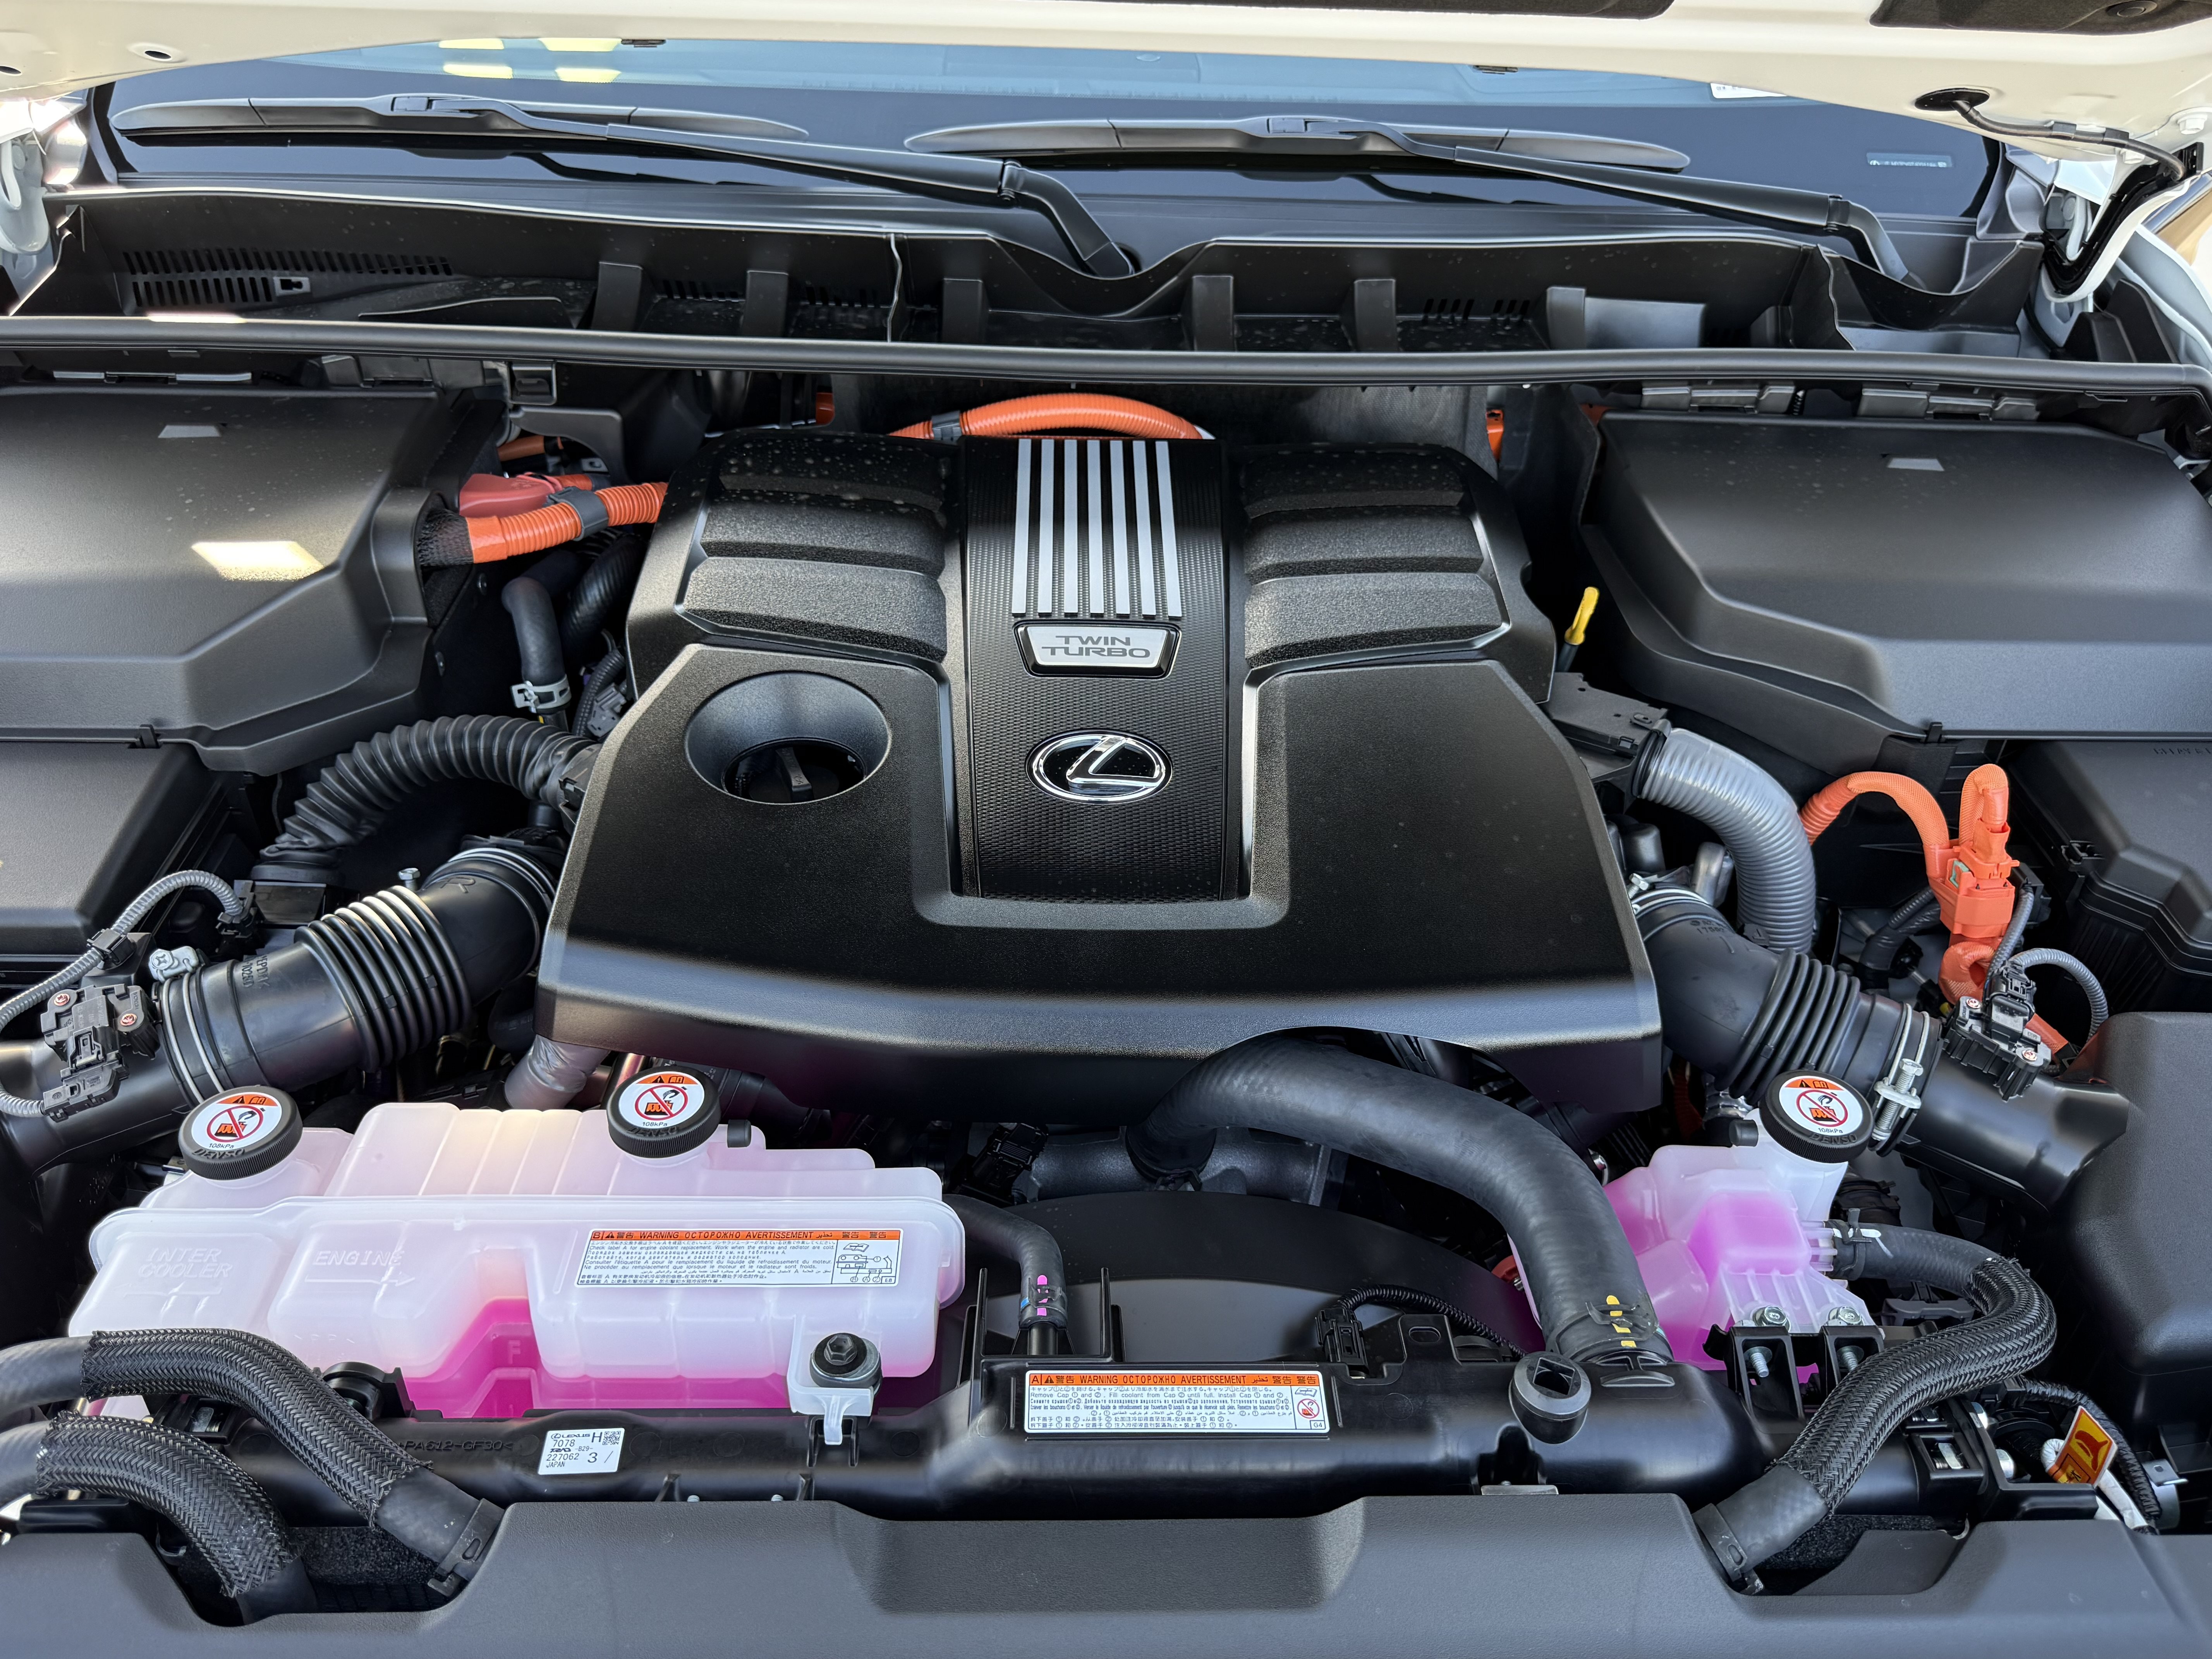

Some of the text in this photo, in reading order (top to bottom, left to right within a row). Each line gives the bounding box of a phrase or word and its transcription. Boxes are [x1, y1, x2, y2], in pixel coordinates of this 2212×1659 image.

[1056, 635, 1131, 646] TWIN
[1042, 646, 1150, 658] TURBO
[626, 1126, 677, 1137] DENSO
[1809, 1133, 1858, 1145] DENSO
[192, 1149, 245, 1159] DENSO
[146, 1248, 222, 1262] INTER
[313, 1250, 405, 1266] ENGINE
[138, 1262, 233, 1278] COOLER
[1056, 1375, 1075, 1384] 警告
[1123, 1376, 1176, 1384] ОСТОРОЖНО
[1181, 1376, 1246, 1384] AVERTISSEMENT
[1273, 1376, 1291, 1384] 警告
[1297, 1376, 1316, 1384] 警告
[592, 1432, 603, 1443] H
[546, 1453, 579, 1461] 227062
[587, 1452, 598, 1463] 3
